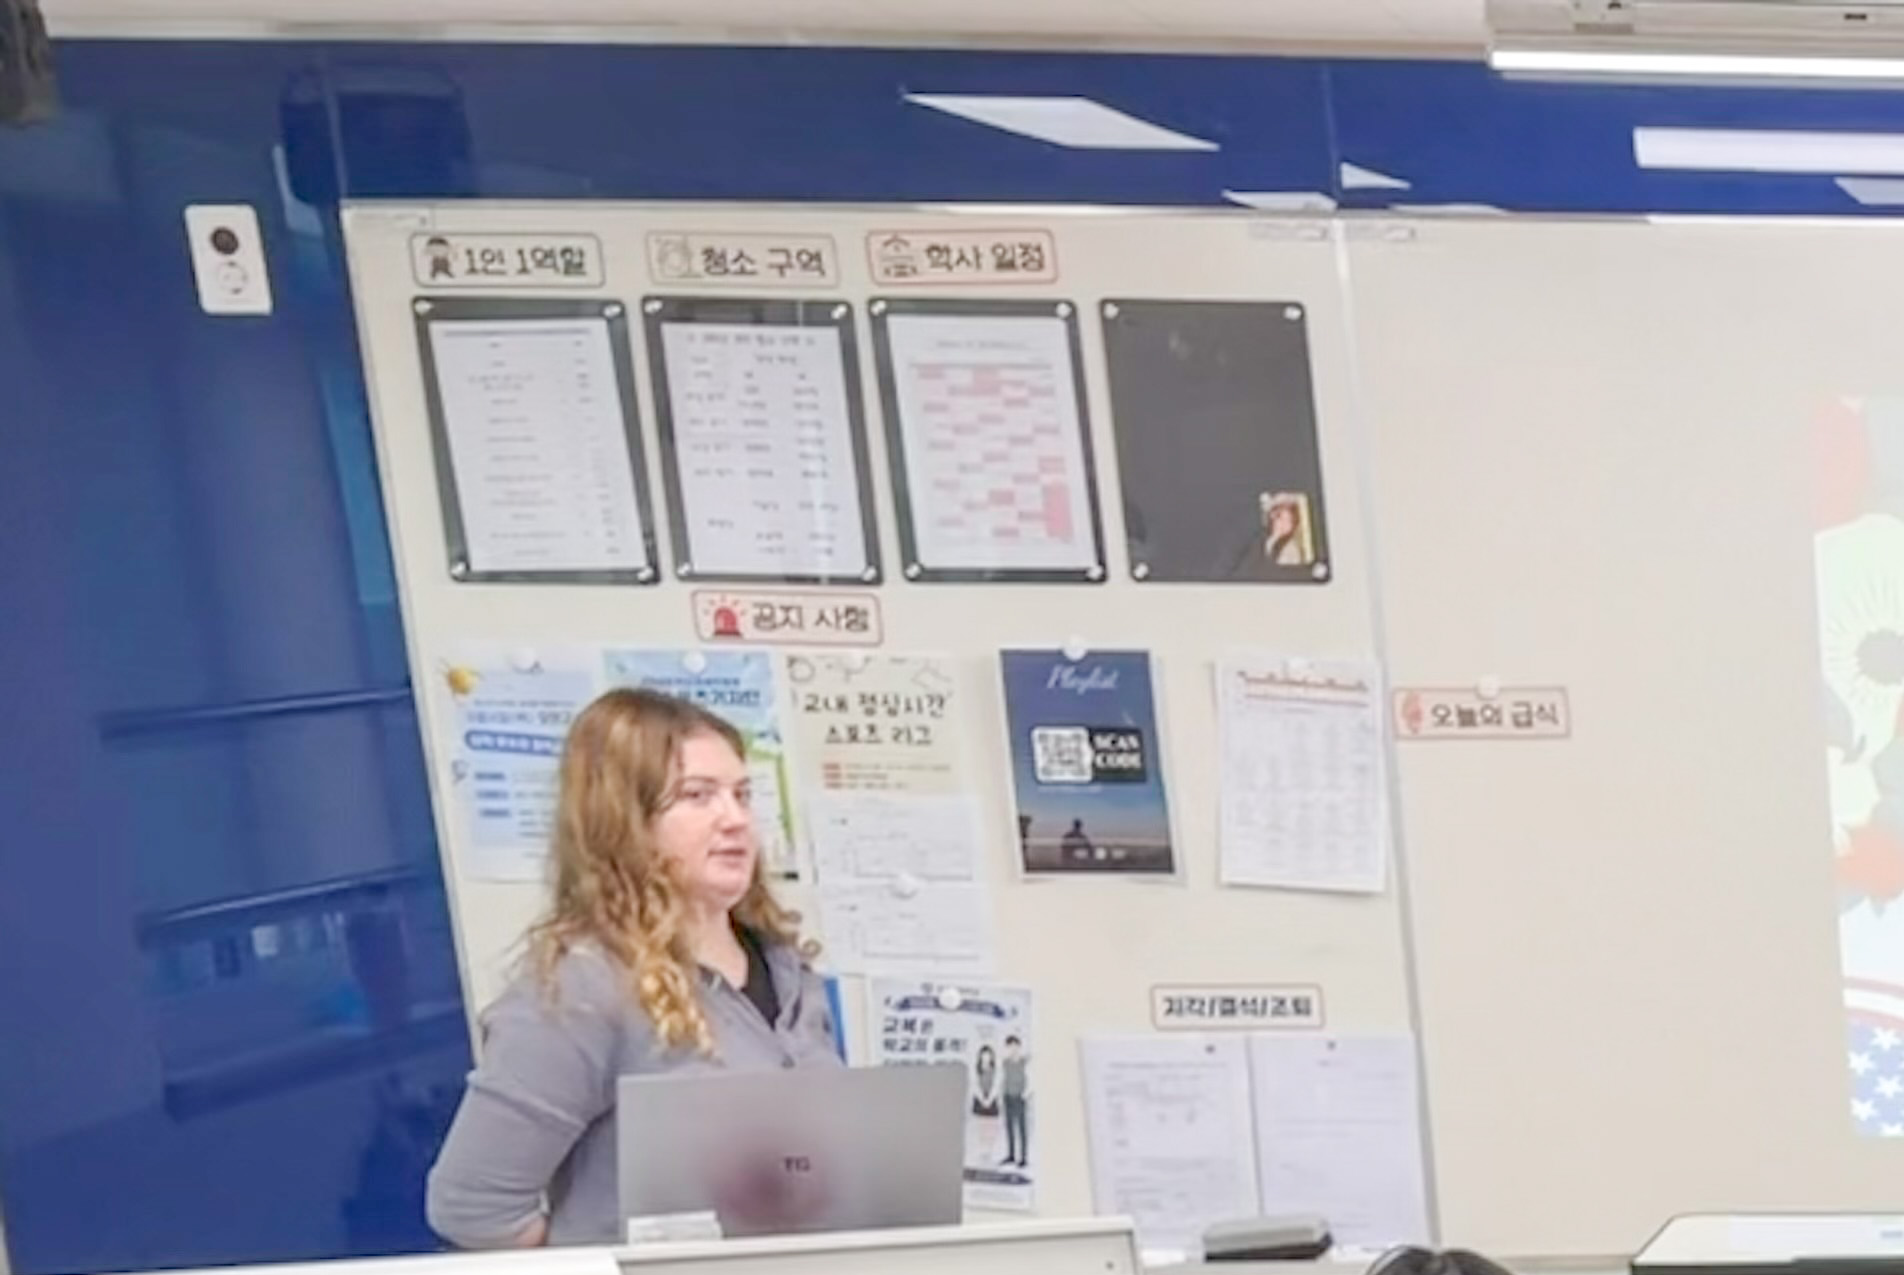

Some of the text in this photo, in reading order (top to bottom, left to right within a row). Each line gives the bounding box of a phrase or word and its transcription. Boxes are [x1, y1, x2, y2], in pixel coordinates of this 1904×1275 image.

[465, 248, 507, 275] 1인
[701, 246, 827, 277] 청소 구역
[925, 242, 1044, 273] 학사 일정
[752, 602, 869, 633] 공지 사항
[1431, 701, 1560, 728] 오늘의 급식
